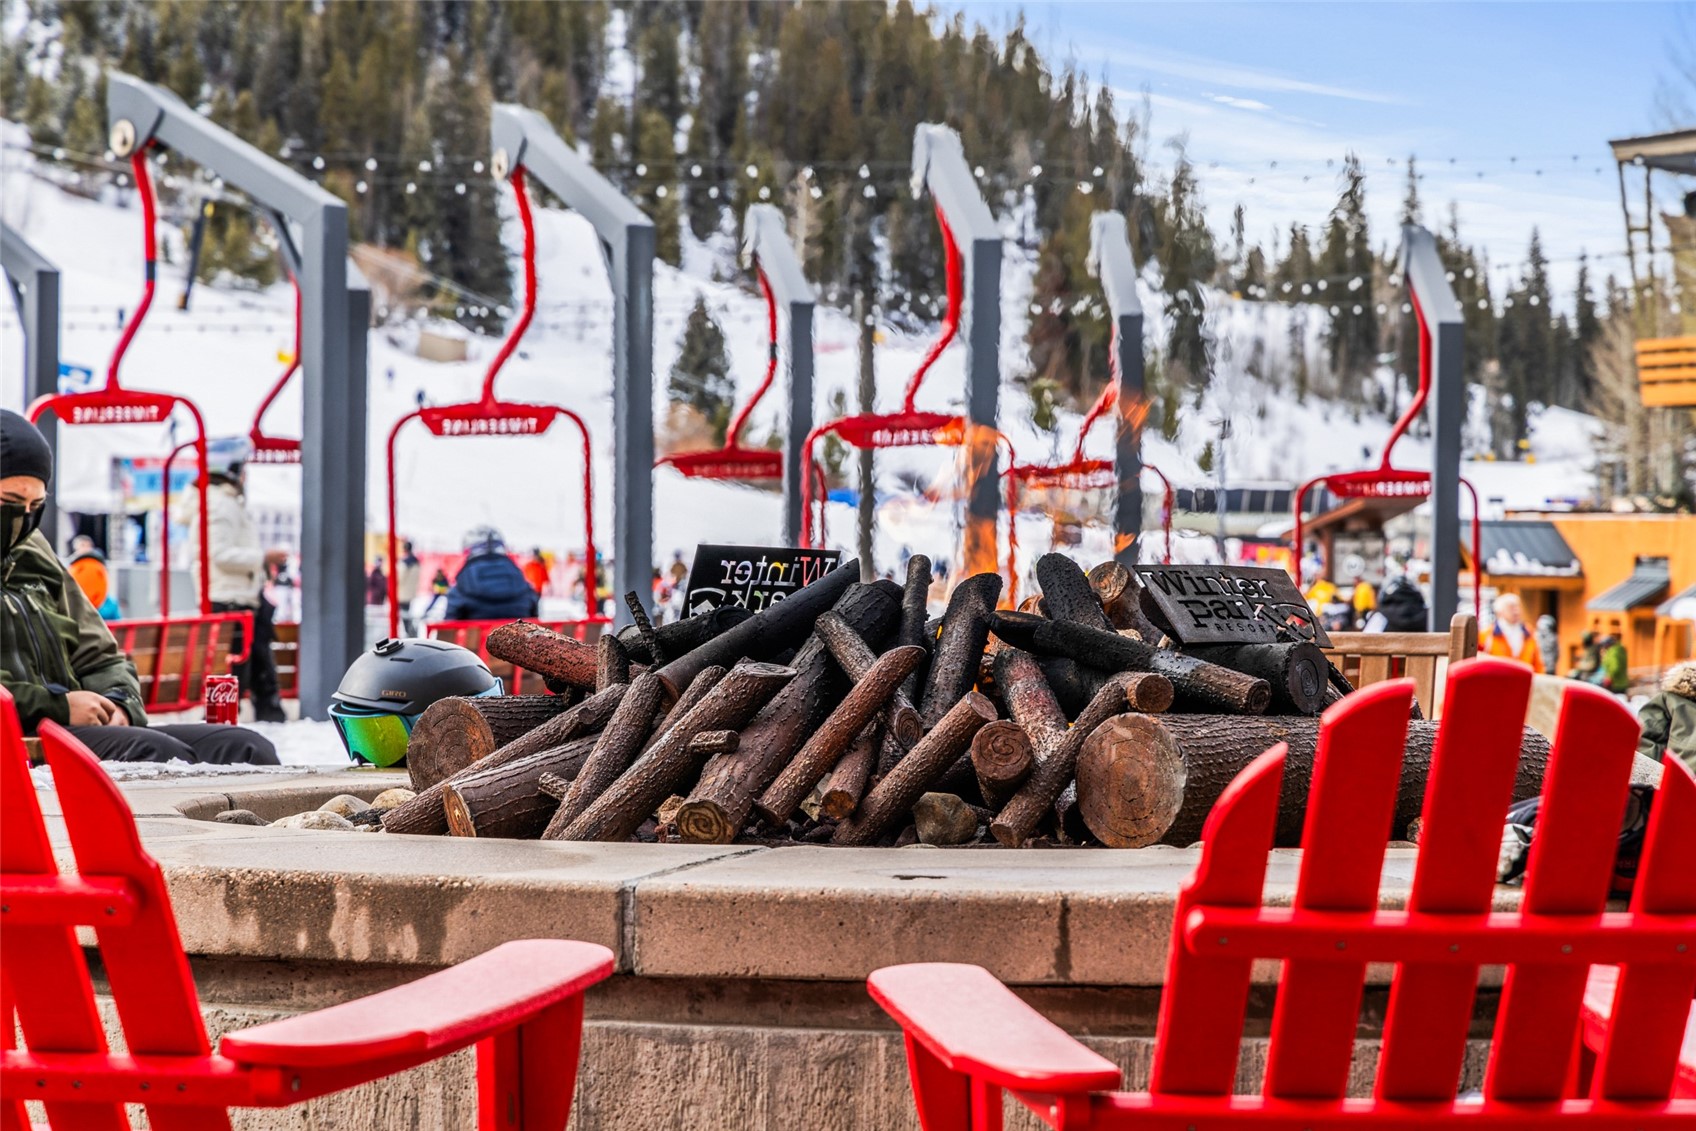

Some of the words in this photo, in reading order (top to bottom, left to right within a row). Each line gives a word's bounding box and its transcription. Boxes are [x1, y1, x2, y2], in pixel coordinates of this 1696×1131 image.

[1141, 571, 1275, 599] Winter
[1178, 596, 1287, 630] park
[1214, 622, 1277, 634] RESORT
[381, 689, 407, 698] GIRO
